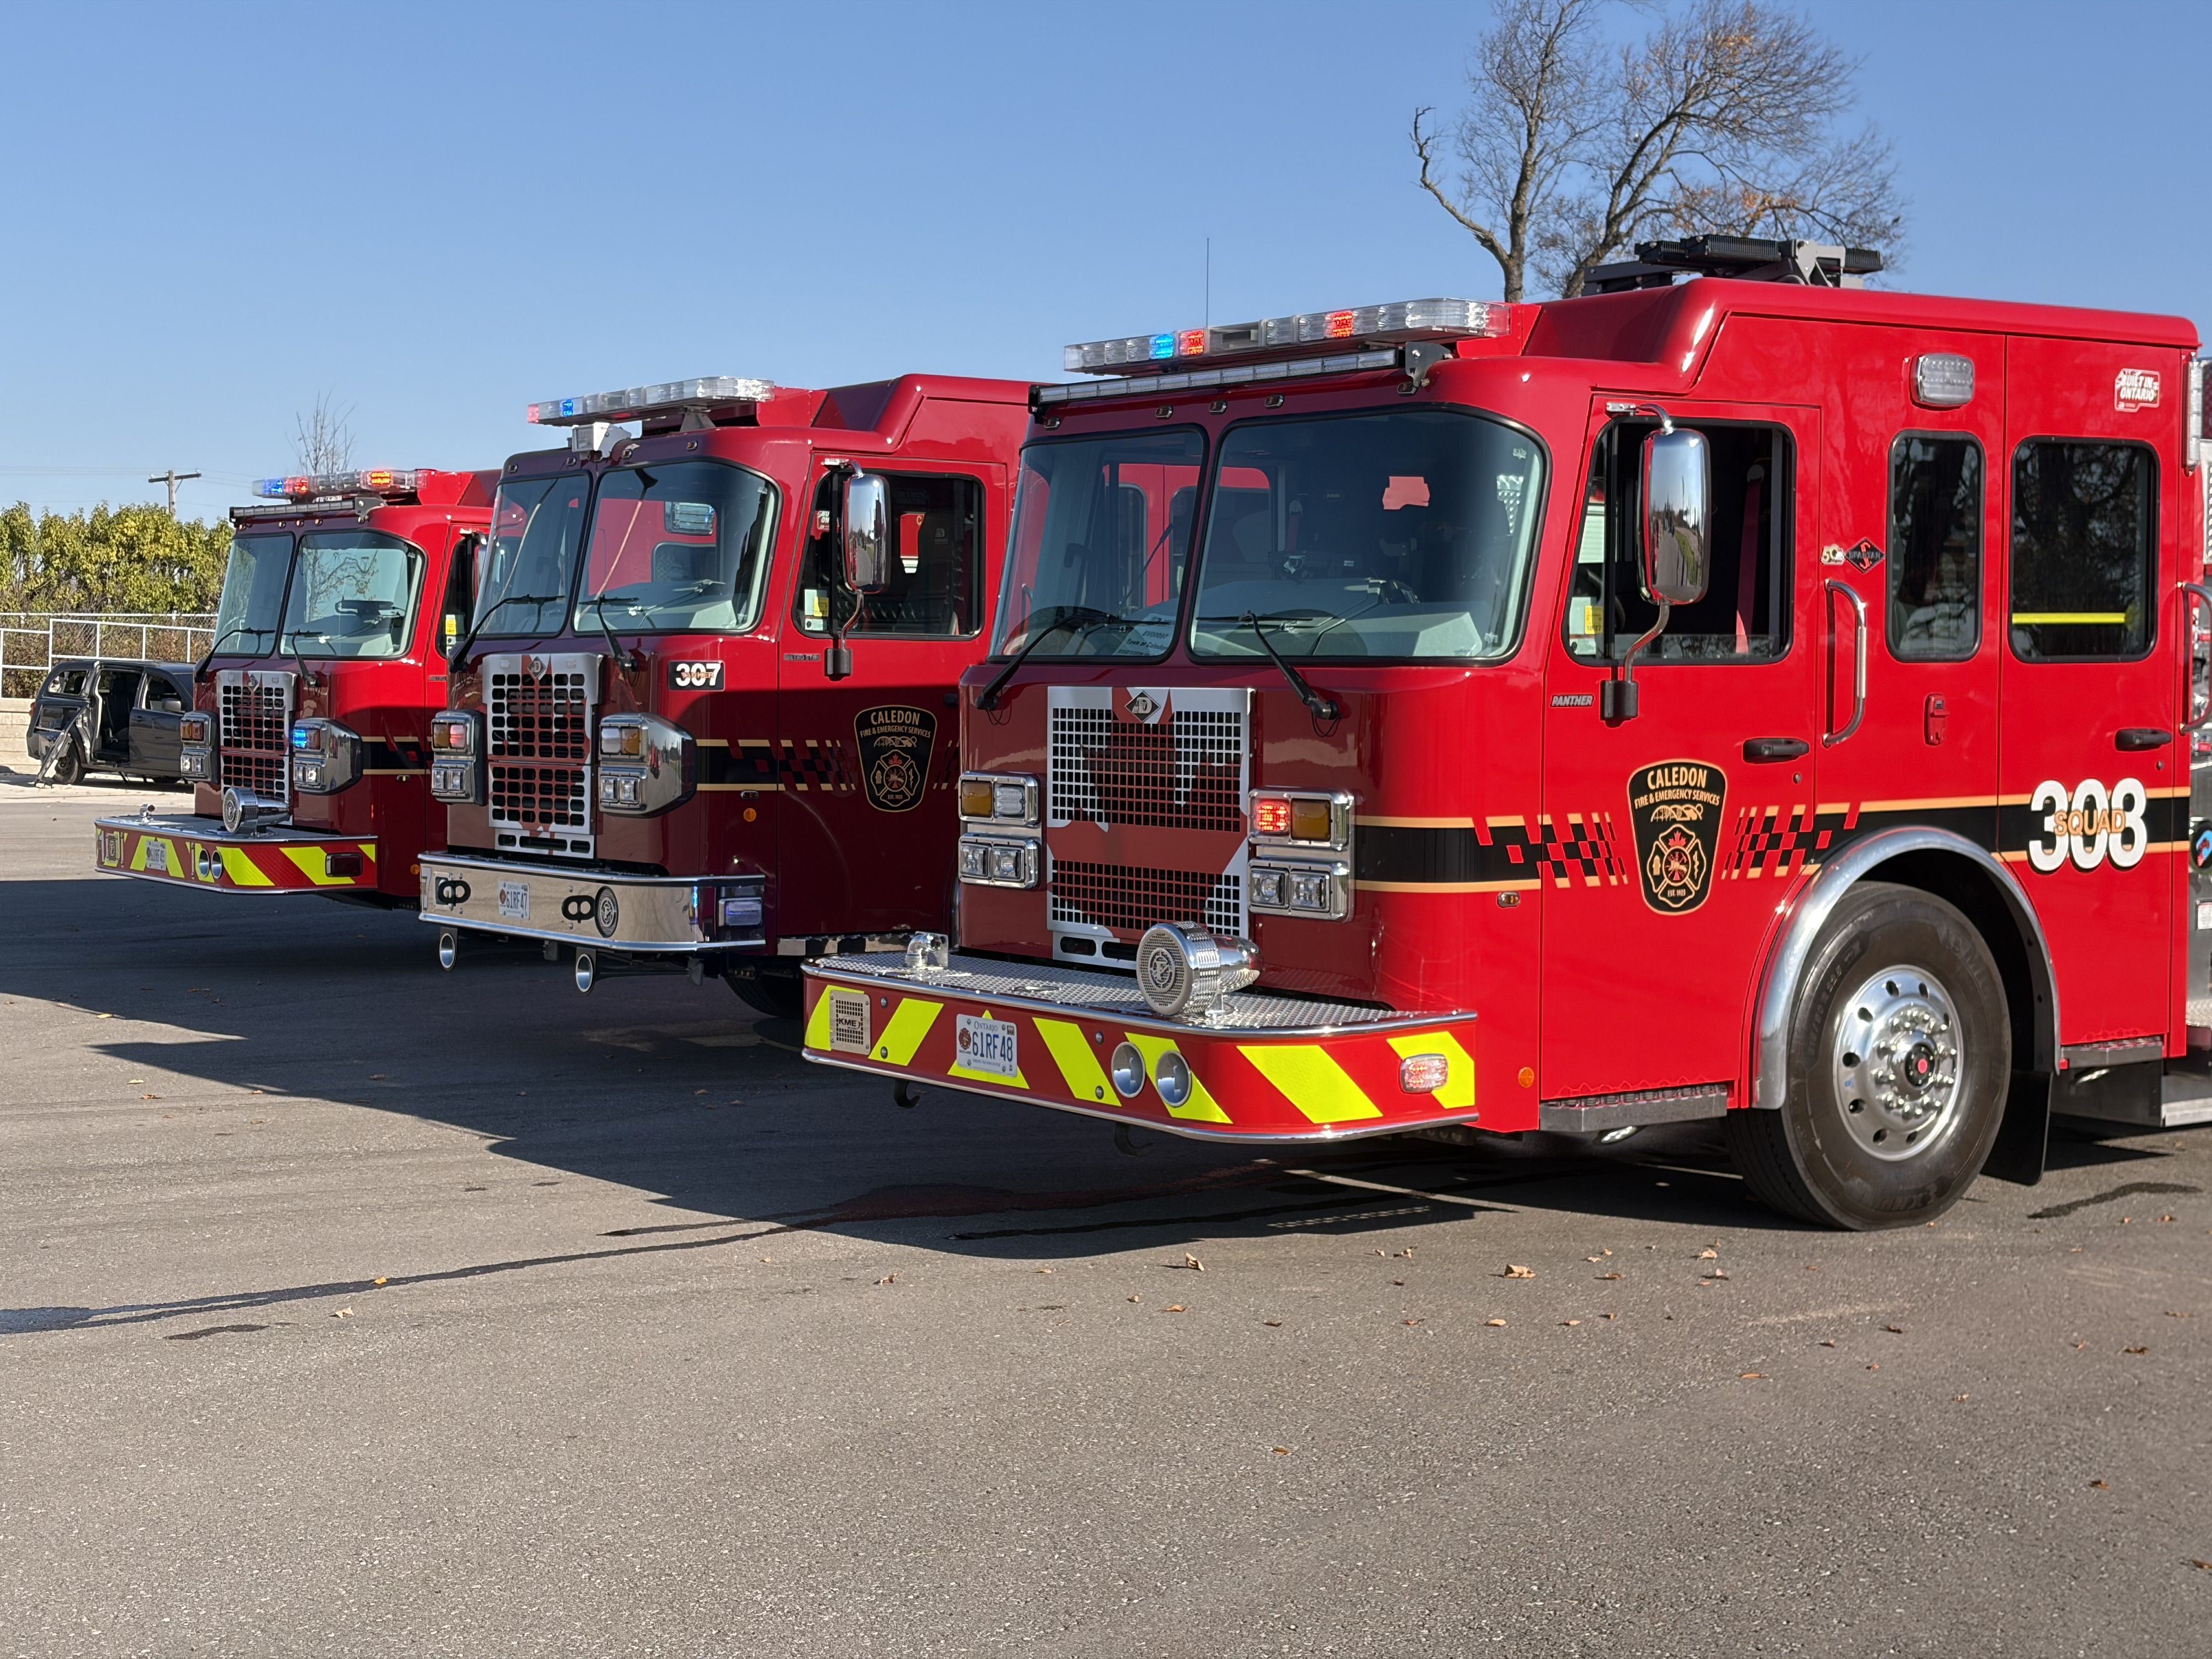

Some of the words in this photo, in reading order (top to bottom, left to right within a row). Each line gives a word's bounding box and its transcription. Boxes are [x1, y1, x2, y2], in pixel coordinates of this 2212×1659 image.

[2120, 387, 2154, 402] ONTARIO
[675, 663, 721, 686] 307
[1551, 695, 1593, 706] PANTHER
[871, 710, 920, 725] CALEDON
[860, 727, 872, 738] FIRE
[877, 725, 907, 734] EMERGENCY
[908, 726, 931, 738] SERVICES
[1647, 766, 1707, 789] CALEDON
[1634, 798, 1649, 809] FIRE
[1649, 793, 1655, 804] &
[1655, 788, 1692, 802] EMERGENCY
[1692, 789, 1720, 806] SERVICES
[2029, 777, 2147, 871] 308
[2053, 807, 2126, 837] SQUAD
[506, 891, 527, 910] 61RF47
[838, 1018, 857, 1027] KME
[974, 1021, 998, 1031] ONTARIO
[972, 1031, 1013, 1062] 61RF48
